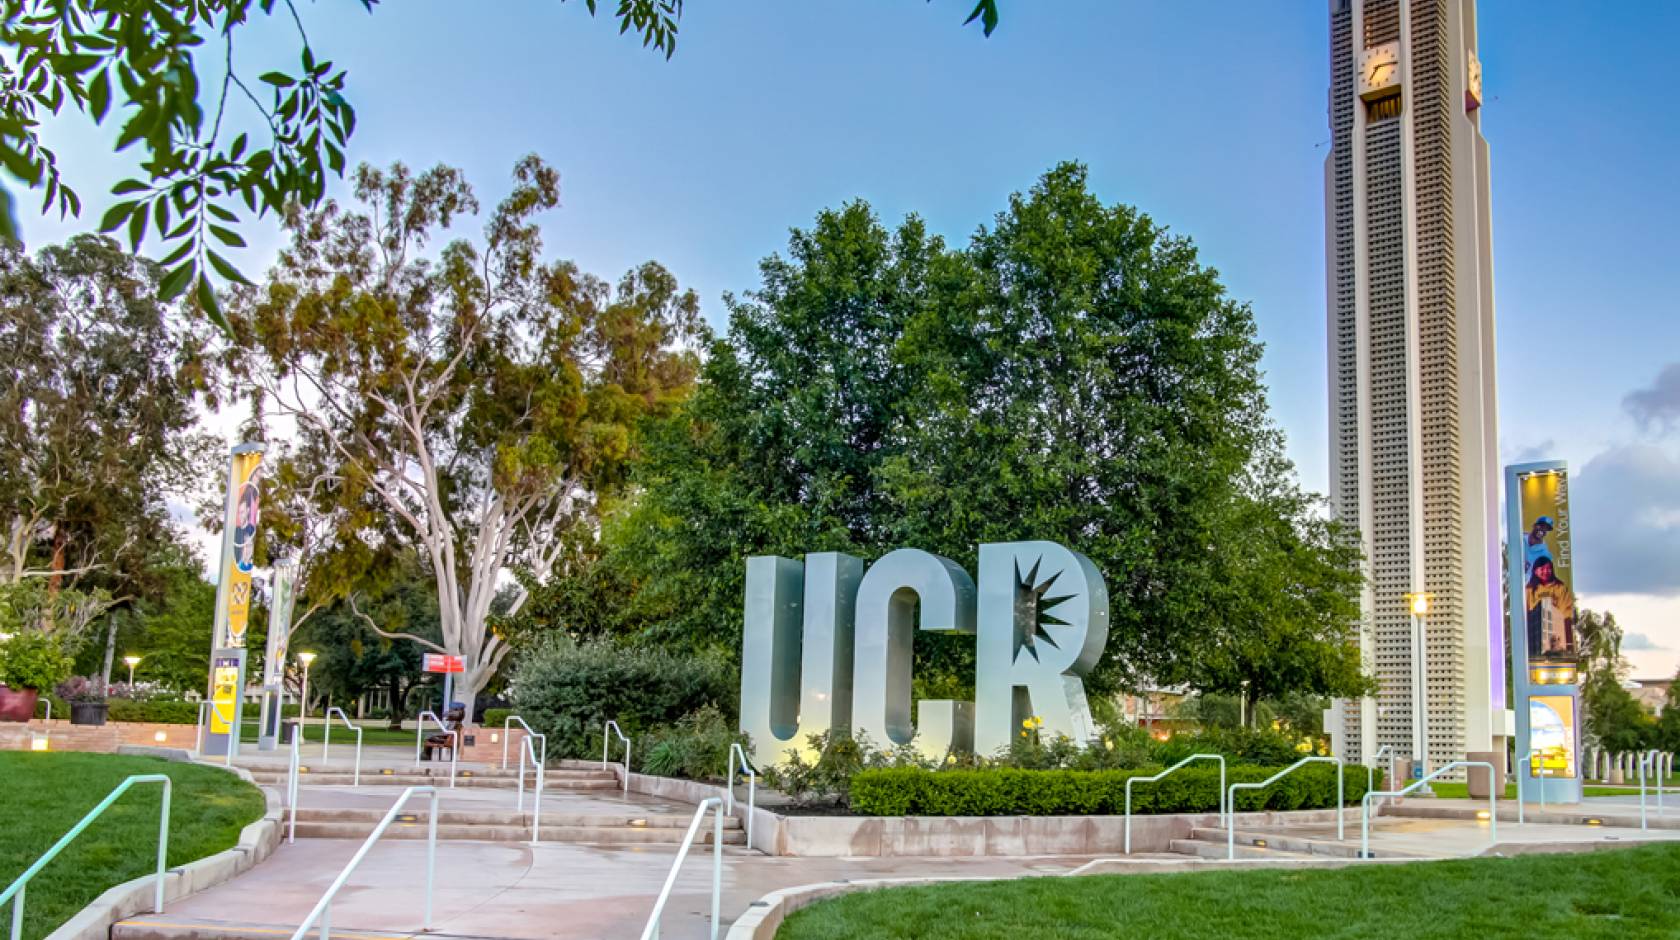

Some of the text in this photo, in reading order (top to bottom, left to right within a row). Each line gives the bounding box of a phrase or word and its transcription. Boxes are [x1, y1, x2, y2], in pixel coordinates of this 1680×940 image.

[1556, 507, 1569, 538] Your
[1558, 541, 1570, 568] Find
[740, 541, 1109, 770] UCR
